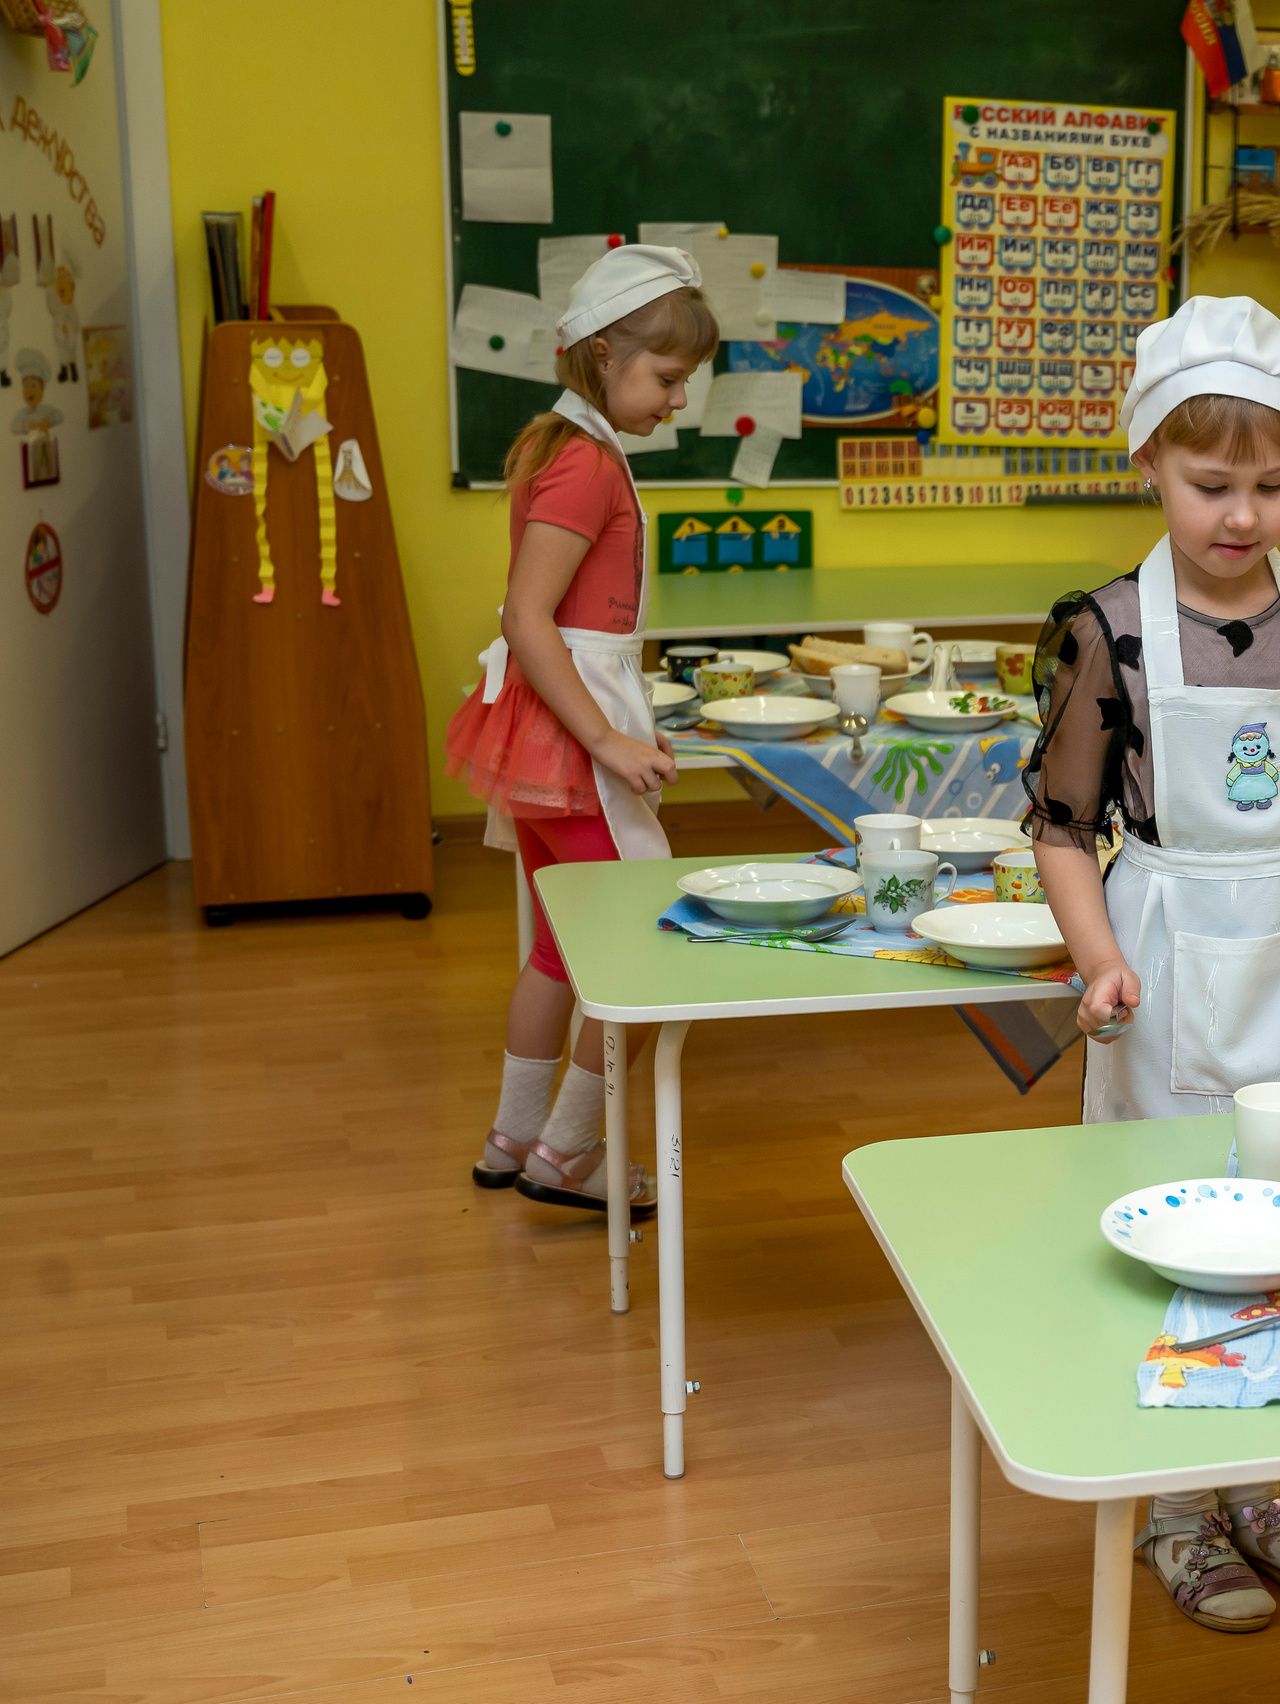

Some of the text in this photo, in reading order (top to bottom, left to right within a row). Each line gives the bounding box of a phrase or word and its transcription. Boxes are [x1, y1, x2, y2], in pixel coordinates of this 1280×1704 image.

[954, 104, 1056, 126] РССКИЙ
[969, 125, 1152, 149] С НАЗВАНИЯМИ БУКВ
[1125, 324, 1143, 340] Ц
[845, 486, 854, 505] 0
[858, 486, 866, 505] 1
[869, 486, 878, 505] 2
[882, 486, 891, 505] 3
[894, 486, 903, 504] 4
[906, 486, 915, 505] 5
[918, 486, 927, 504] 6
[930, 485, 939, 504] 7
[942, 485, 951, 504] 8
[955, 486, 964, 504] 9
[969, 485, 984, 504] 10
[988, 485, 1002, 504] 11
[1007, 484, 1024, 503] 12
